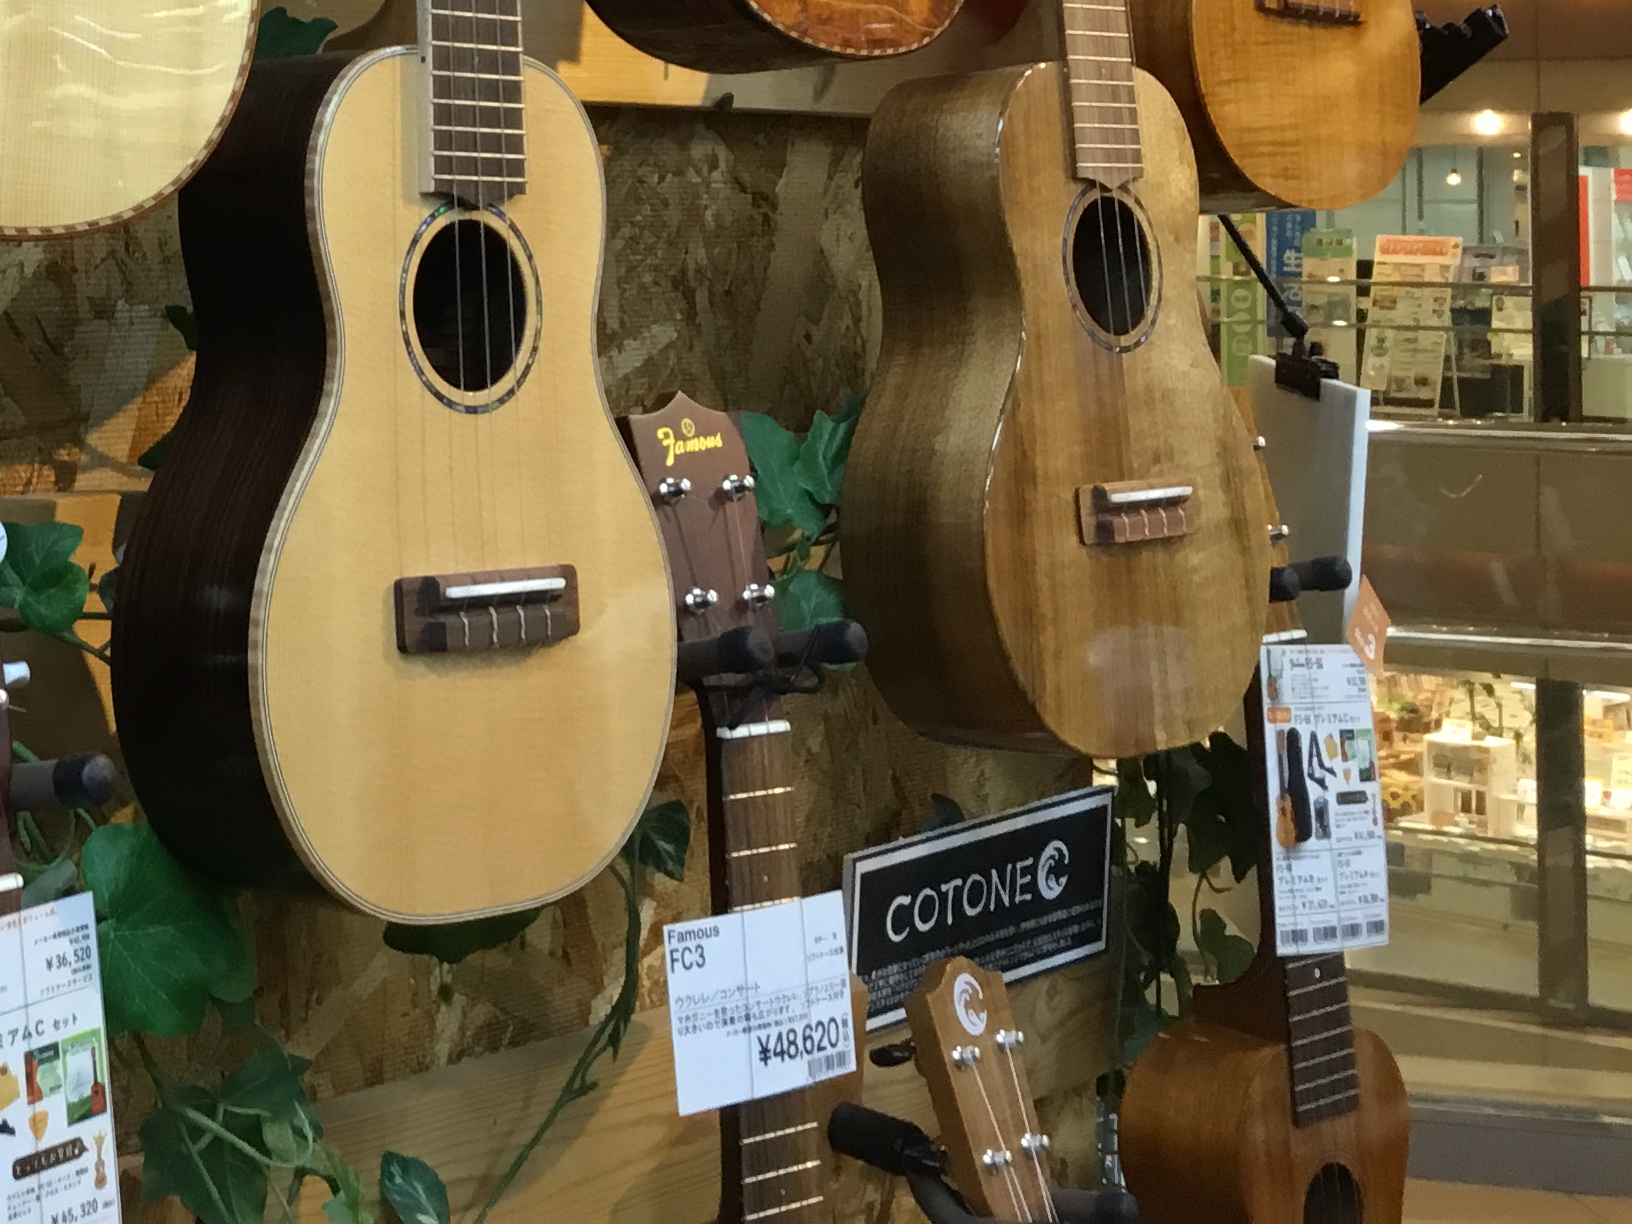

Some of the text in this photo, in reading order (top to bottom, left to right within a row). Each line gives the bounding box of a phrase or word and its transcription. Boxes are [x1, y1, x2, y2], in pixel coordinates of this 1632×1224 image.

[656, 426, 723, 467] Famous
[886, 857, 1035, 943] COTONE
[668, 924, 720, 945] Famous
[669, 944, 707, 974] FC3
[757, 1016, 840, 1067] ¥48,620
